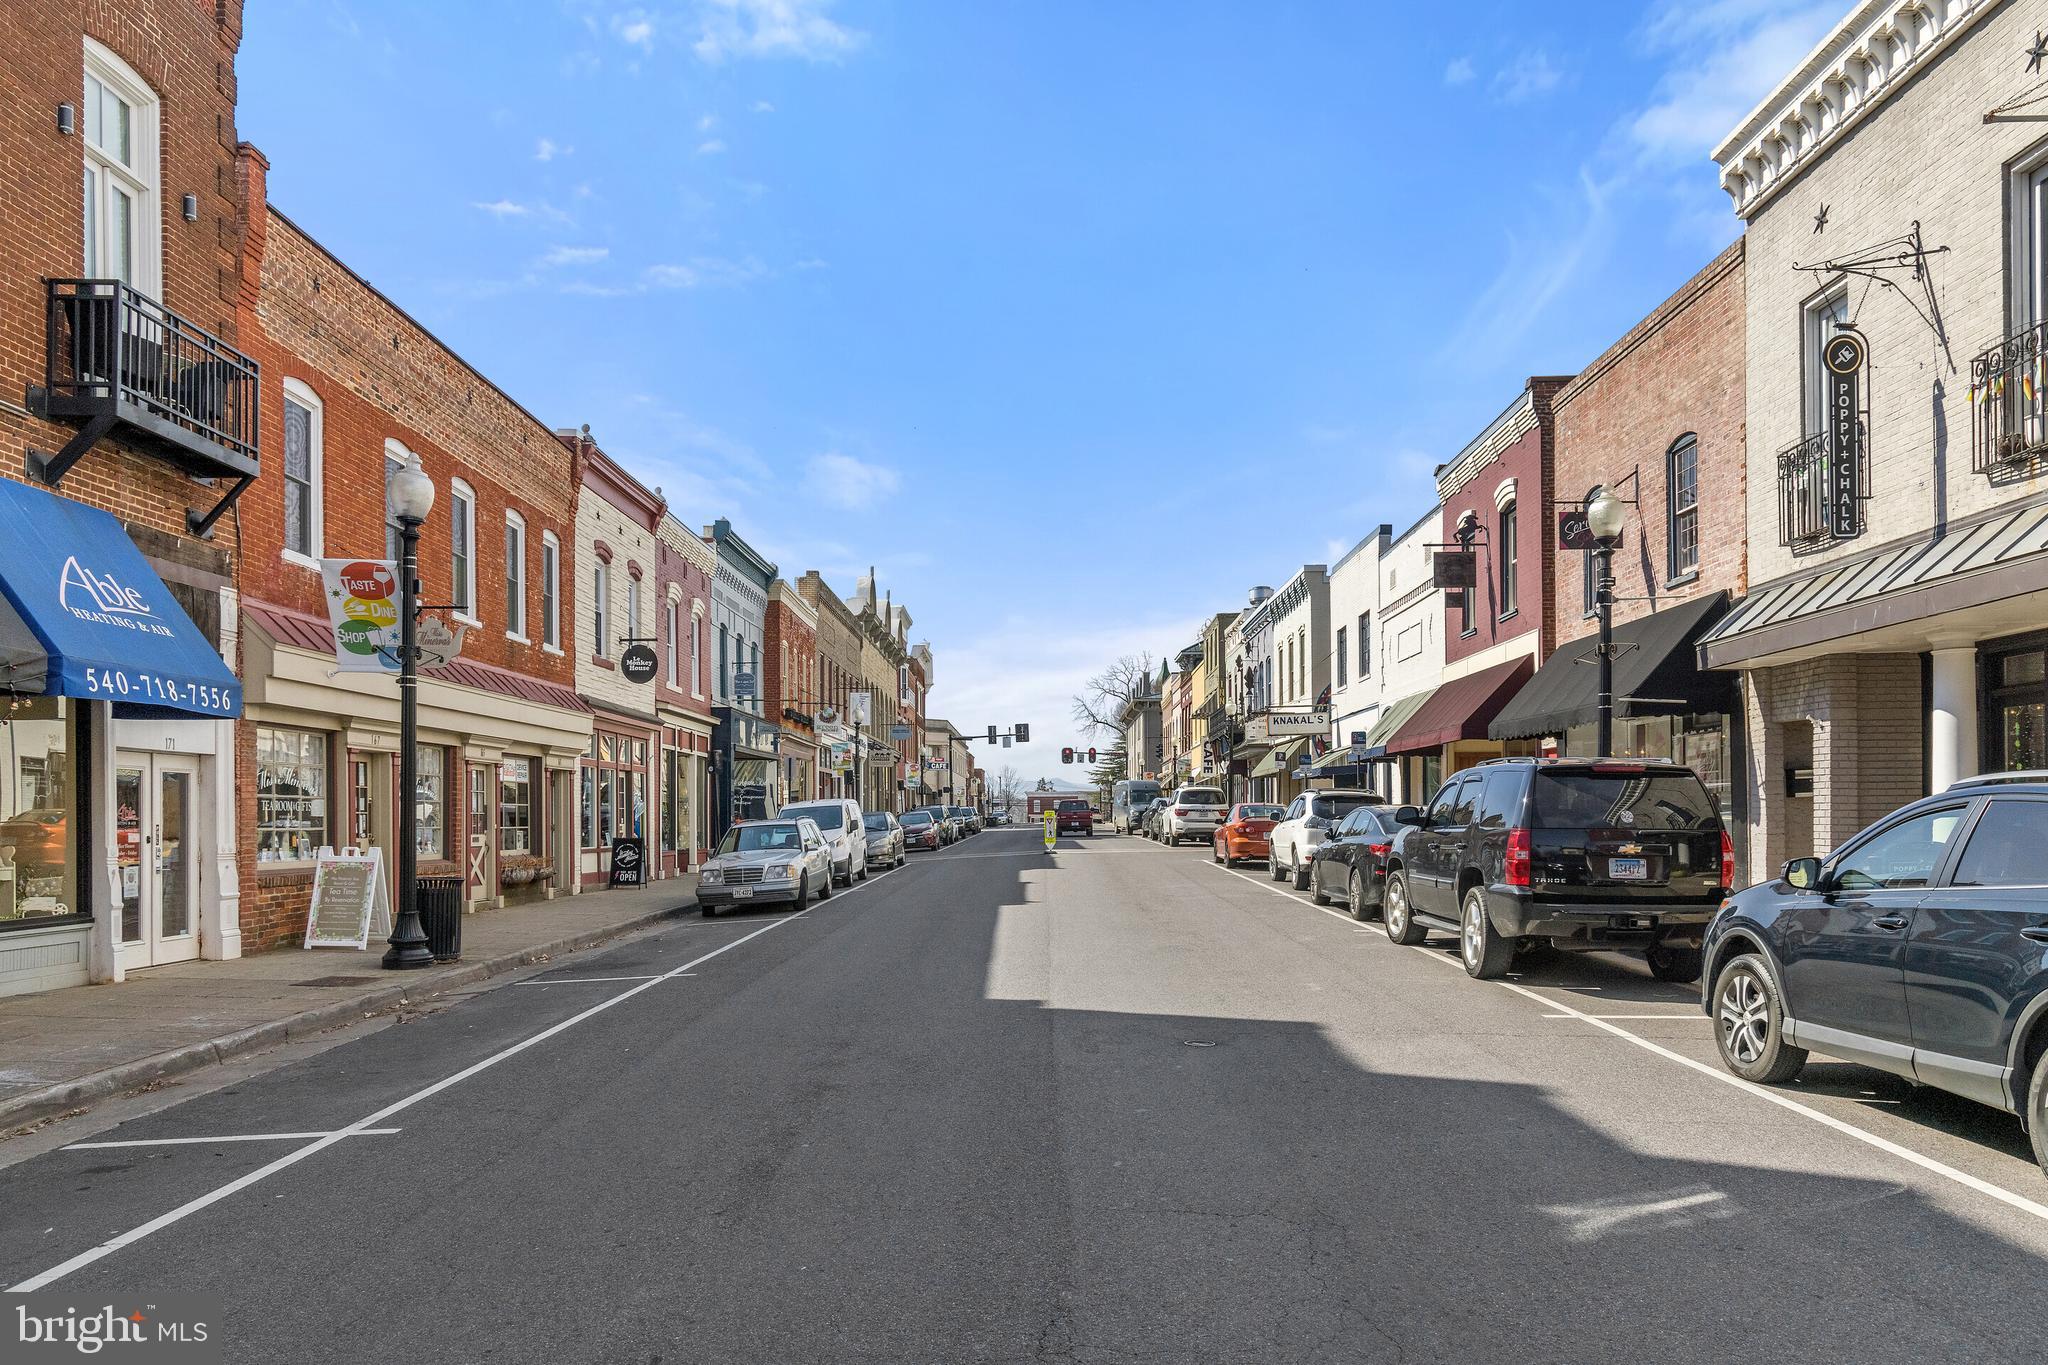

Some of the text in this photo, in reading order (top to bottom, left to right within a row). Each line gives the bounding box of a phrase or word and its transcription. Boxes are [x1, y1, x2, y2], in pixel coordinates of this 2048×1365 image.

[1838, 383, 1850, 446] POPPY
[1840, 463, 1851, 531] CHALK
[59, 555, 150, 613] Able
[340, 576, 376, 592] TASTE
[69, 606, 175, 638] HEATING & AIR
[371, 602, 398, 619] DINE
[337, 628, 366, 643] SHOP
[86, 668, 231, 710] 540-718-7556
[1273, 715, 1324, 725] KNAKAL'S
[165, 737, 175, 750] 171
[1203, 740, 1213, 774] CAFE
[620, 873, 637, 881] OPEN
